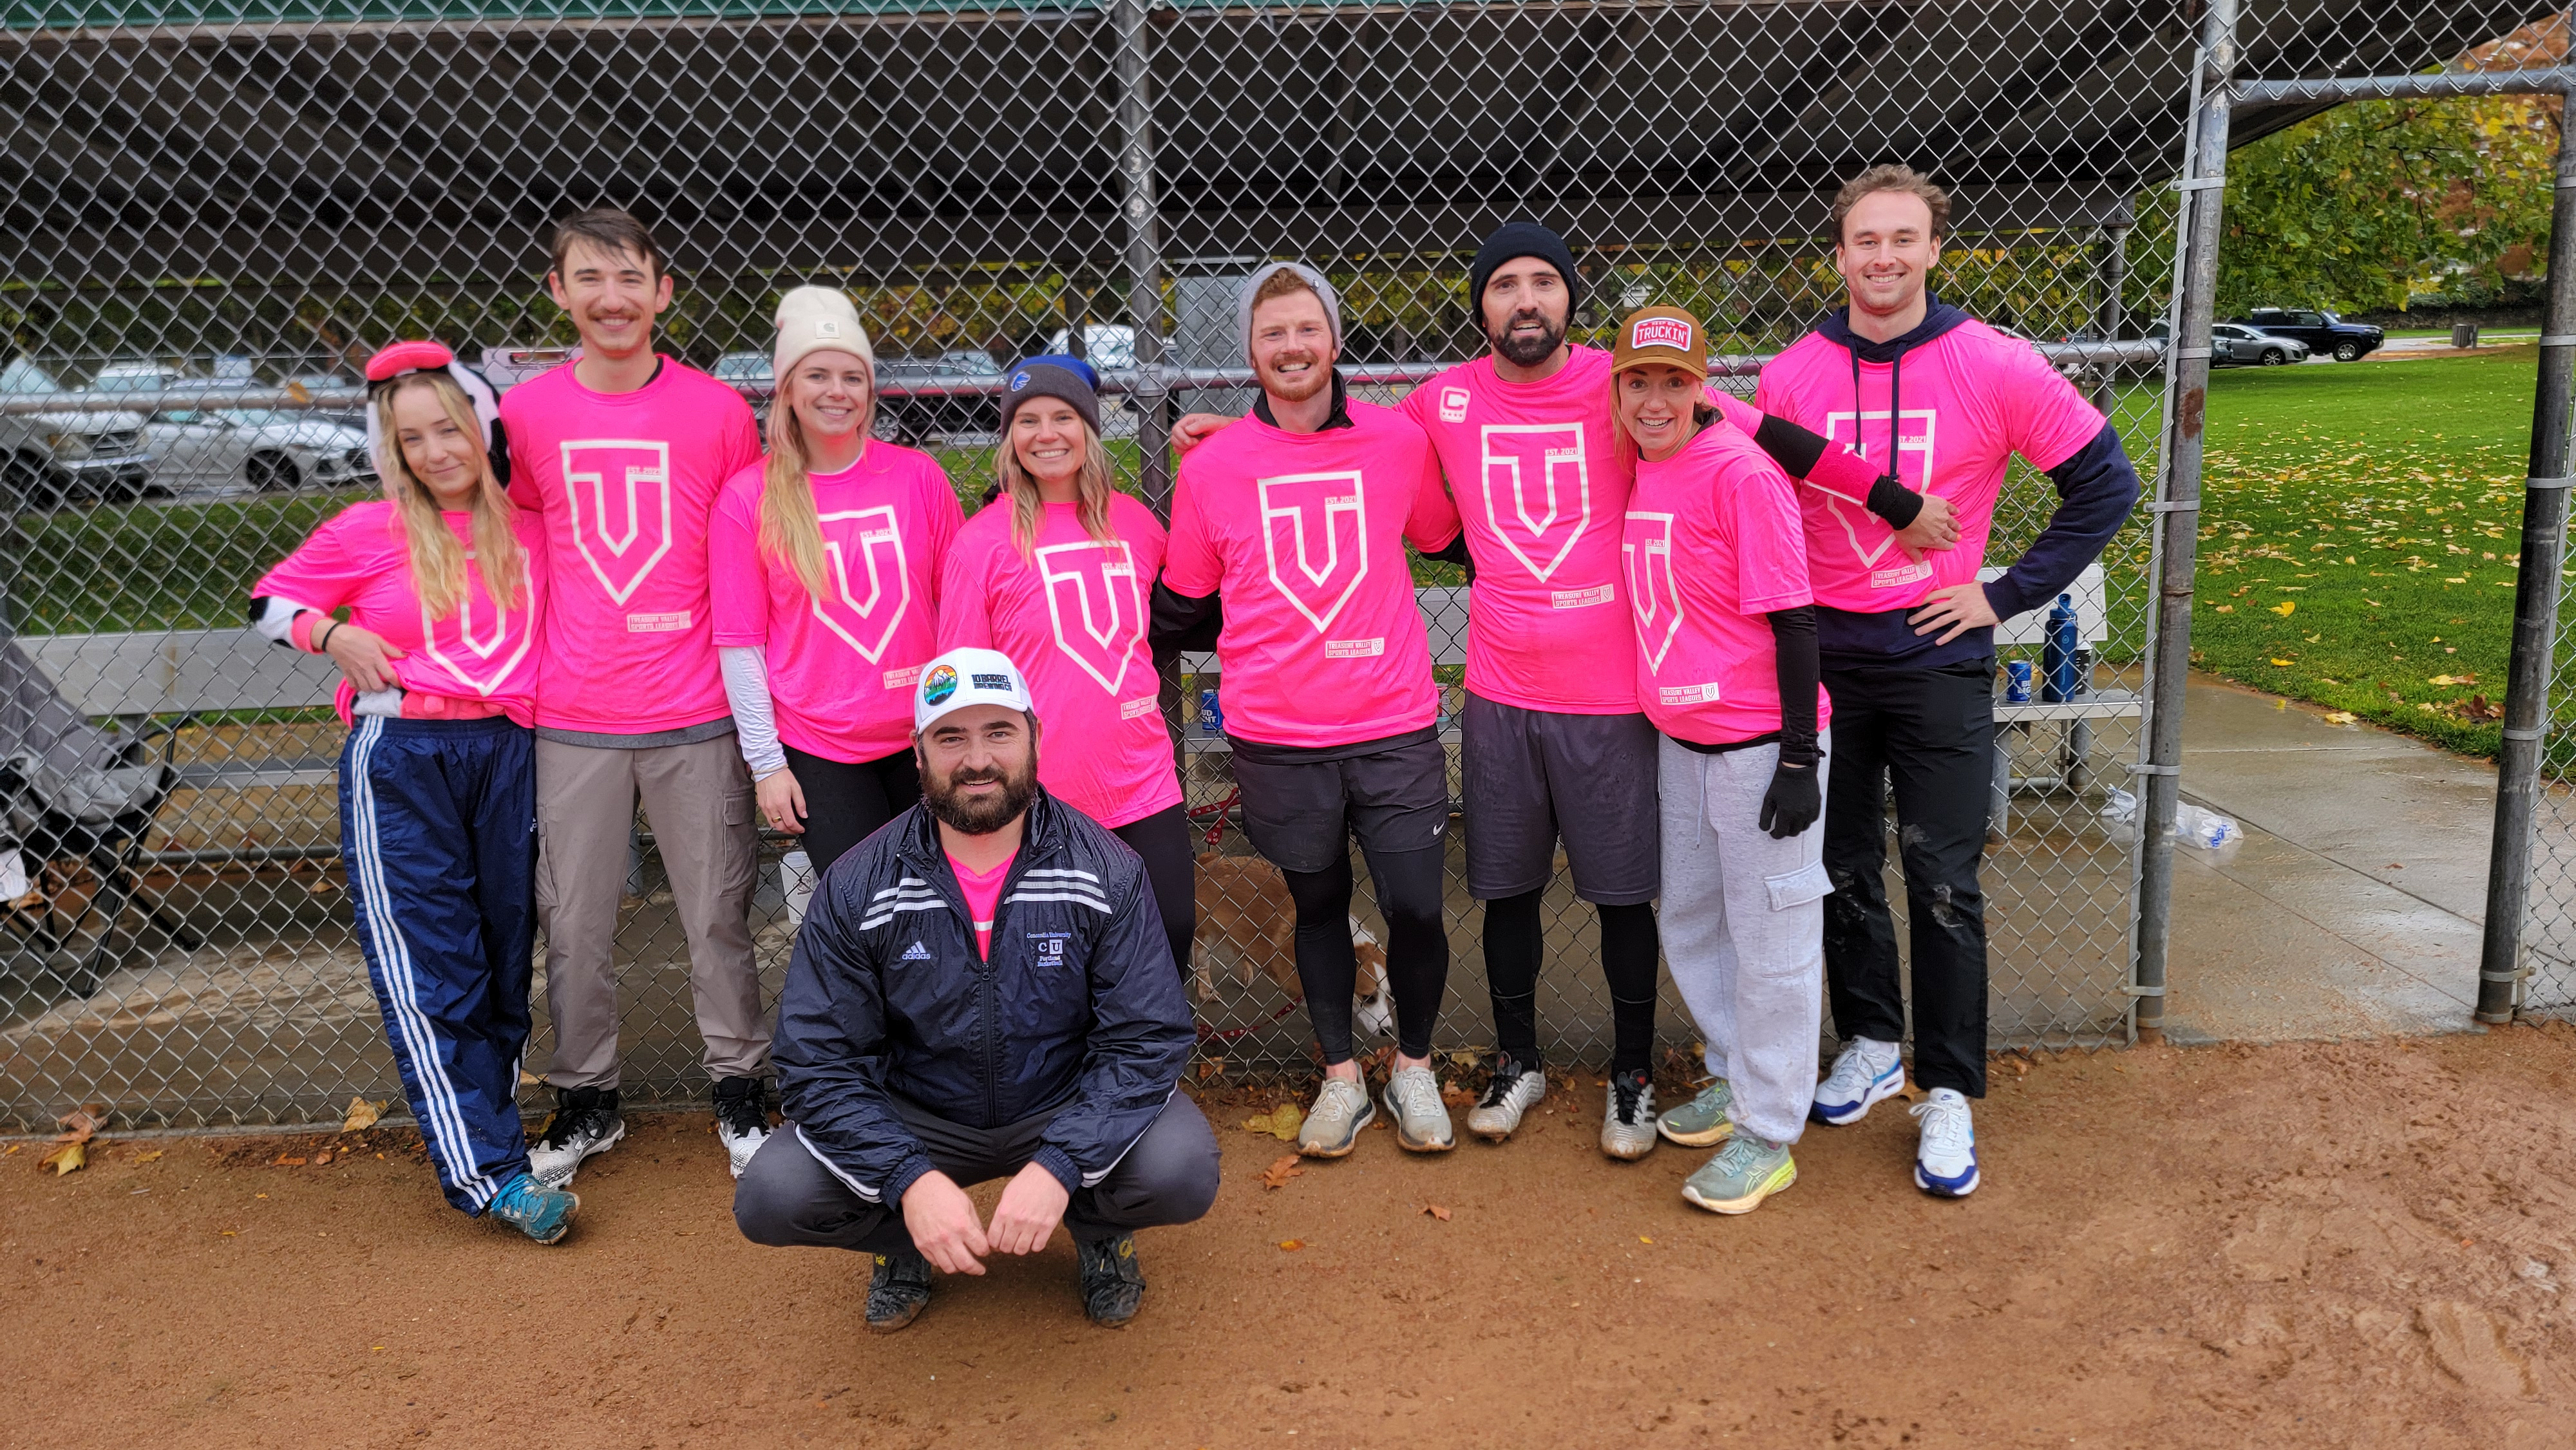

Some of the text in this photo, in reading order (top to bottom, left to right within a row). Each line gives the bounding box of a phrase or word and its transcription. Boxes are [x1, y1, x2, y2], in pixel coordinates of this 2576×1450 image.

[1638, 325, 1687, 343] TRUCKIN'
[1560, 447, 1578, 455] 2021
[1578, 596, 1600, 605] LEAGUES
[1680, 694, 1702, 702] LEAGUES
